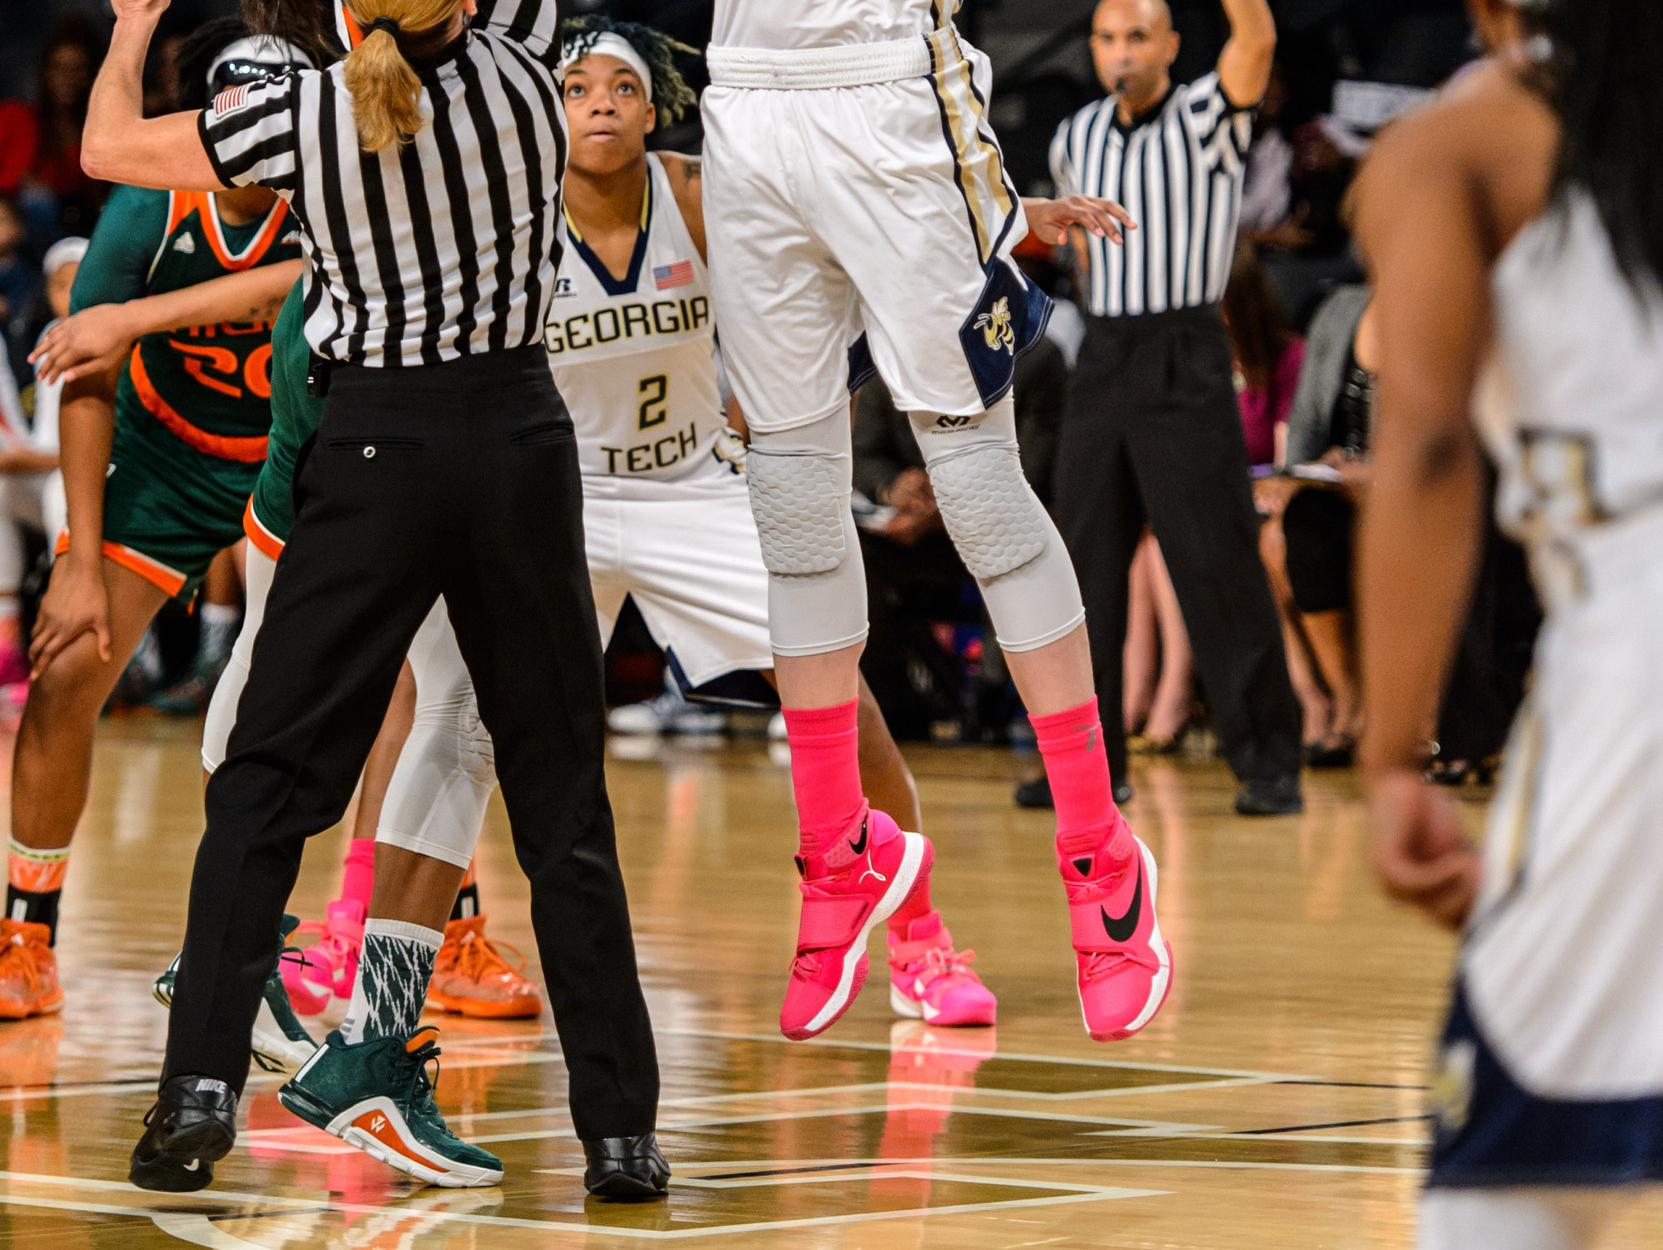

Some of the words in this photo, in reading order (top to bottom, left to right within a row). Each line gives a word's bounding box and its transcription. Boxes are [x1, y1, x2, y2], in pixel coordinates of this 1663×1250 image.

[544, 294, 709, 354] GEORGIA
[637, 373, 668, 432] 2
[600, 421, 698, 475] TECH
[195, 1078, 227, 1094] NIKE
